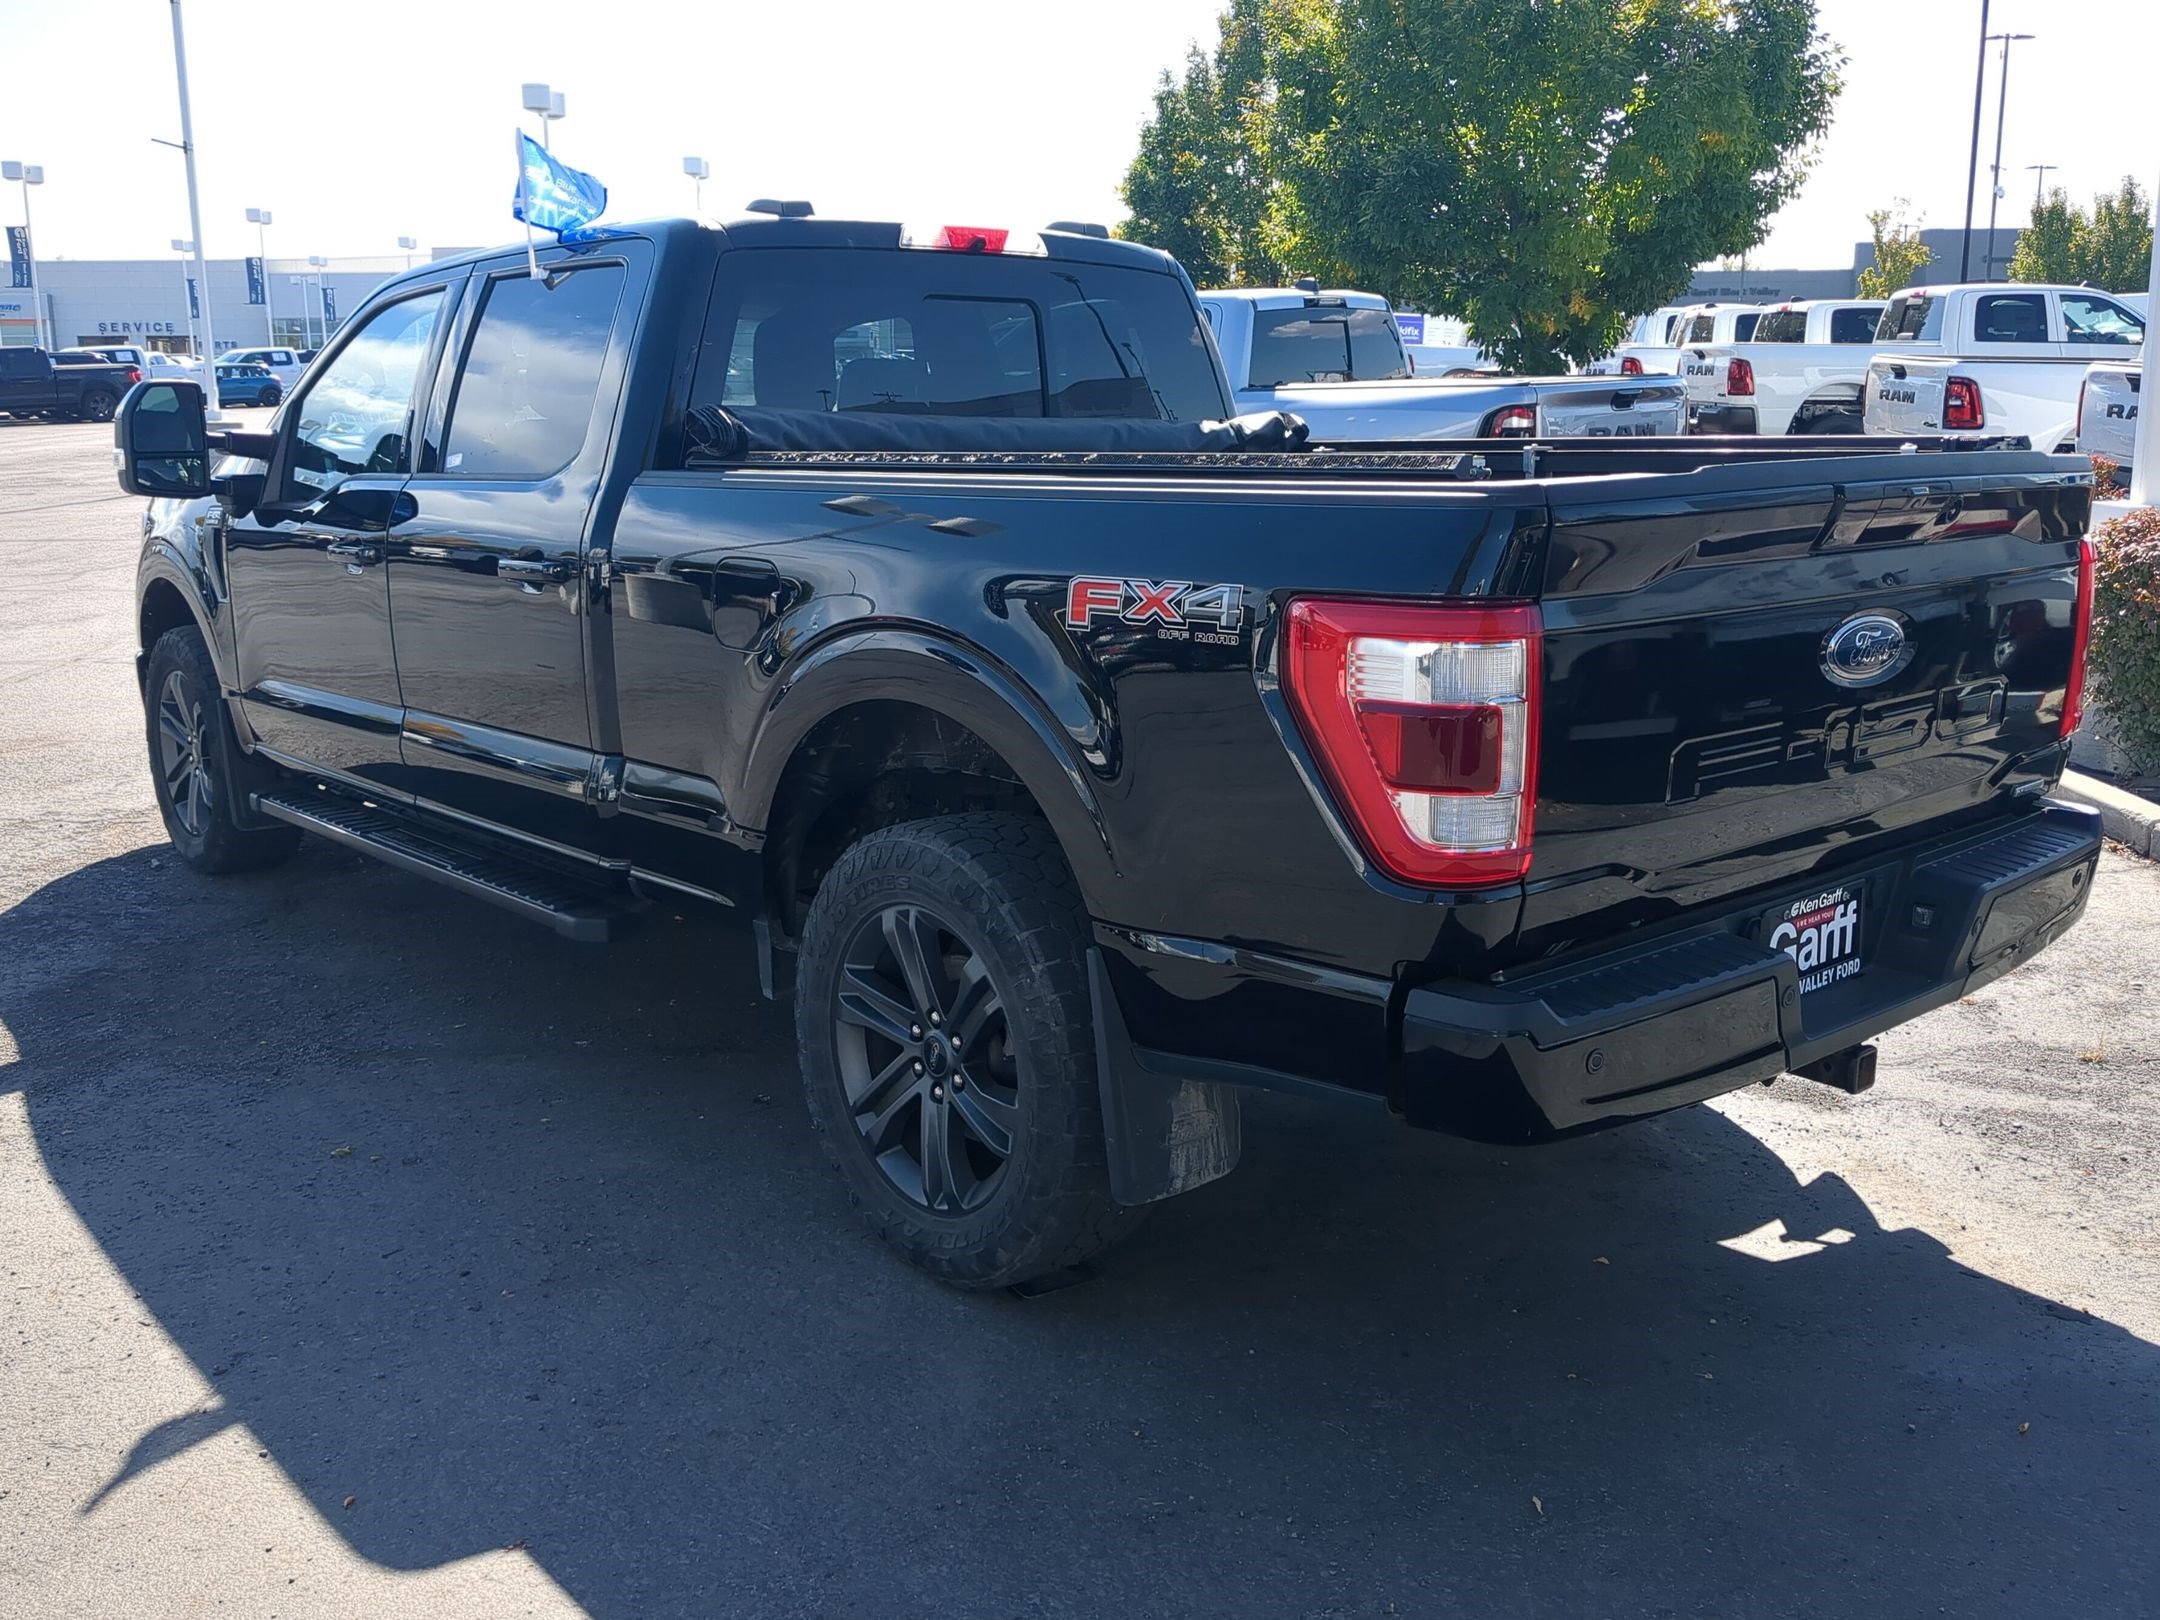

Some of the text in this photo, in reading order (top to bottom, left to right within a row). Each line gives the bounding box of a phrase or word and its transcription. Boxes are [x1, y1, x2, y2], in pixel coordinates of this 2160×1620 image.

[98, 321, 175, 333] SERVICE
[1686, 364, 1715, 376] RAM
[1879, 389, 1916, 404] RAM
[2106, 403, 2139, 420] RA
[1066, 574, 1244, 633] FX4
[1157, 628, 1240, 646] OFF ROAD
[1849, 630, 1901, 666] Ford
[1665, 674, 2009, 806] F-150
[1798, 887, 1844, 916] Ken Garff
[1799, 958, 1861, 995] VALLEY FORD
